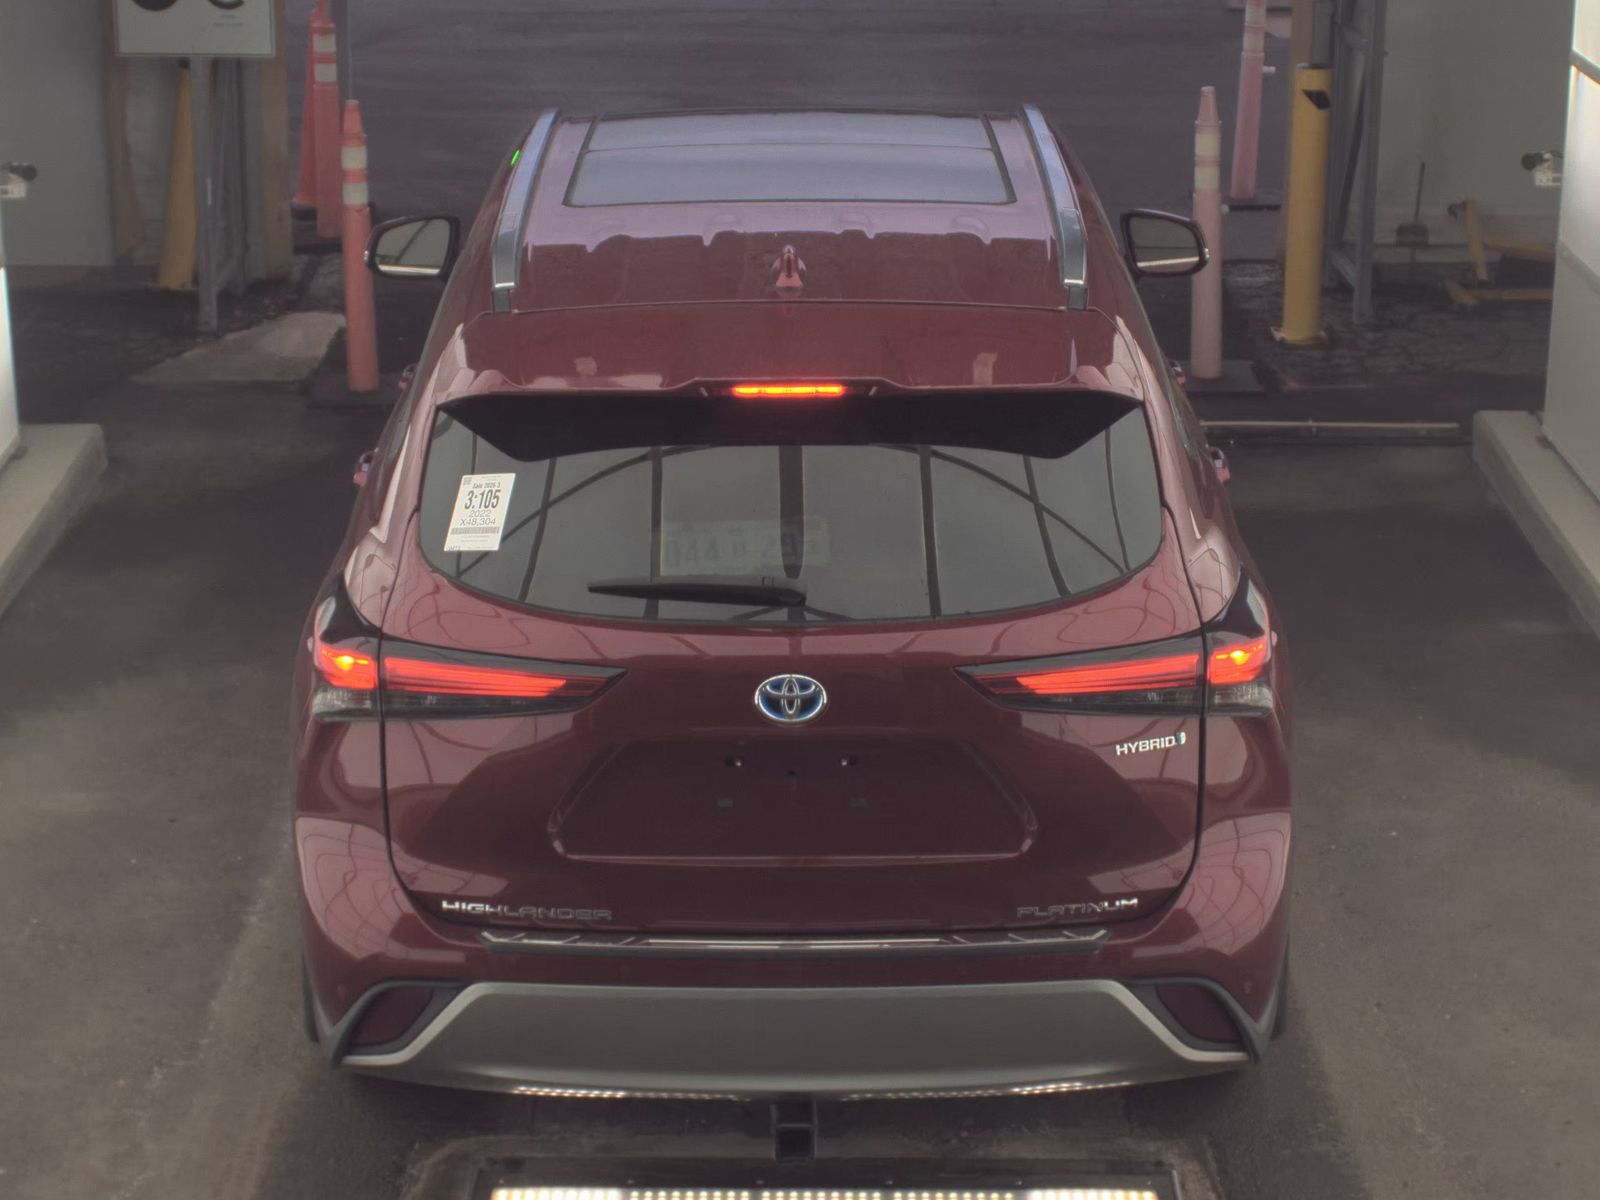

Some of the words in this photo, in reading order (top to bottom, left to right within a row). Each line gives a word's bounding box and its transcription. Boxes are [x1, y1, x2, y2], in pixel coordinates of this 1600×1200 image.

[464, 488, 502, 510] 3:105
[468, 509, 492, 518] 2022
[1115, 735, 1176, 756] HYBRID
[441, 900, 613, 921] HIGHLANDER
[1016, 898, 1138, 920] PLATINUM
